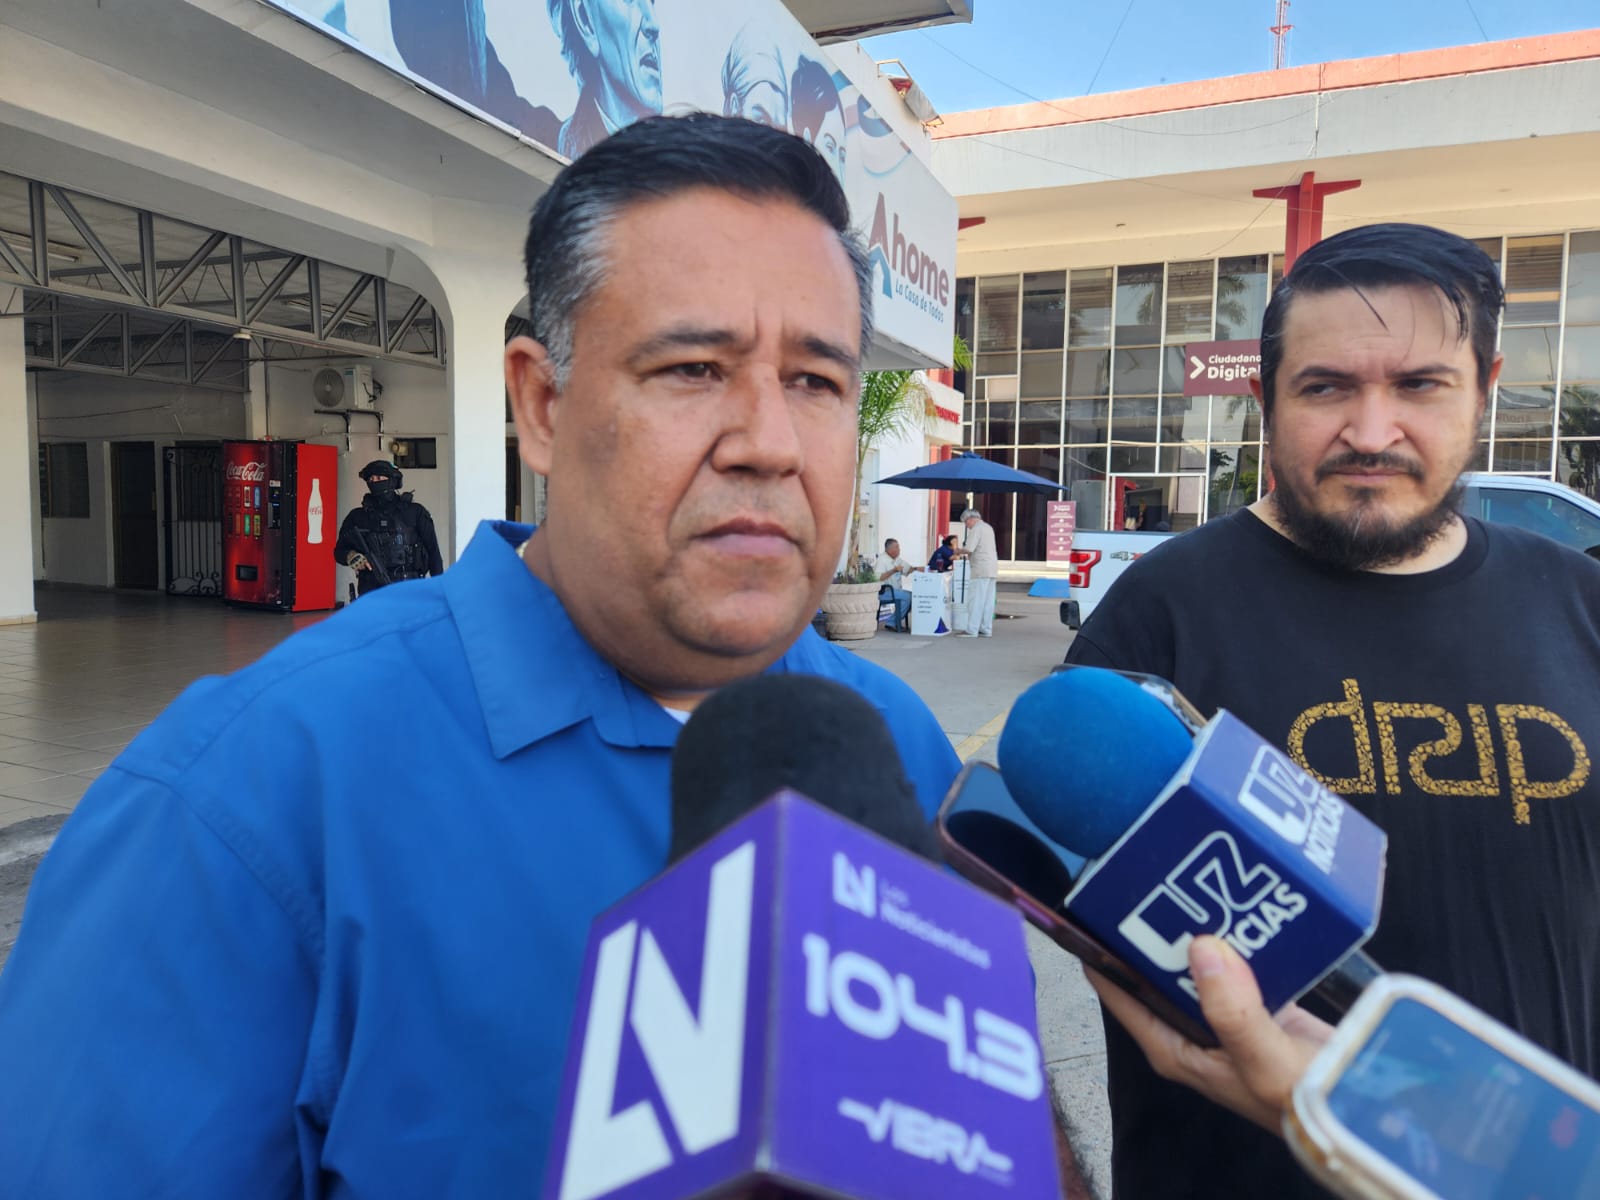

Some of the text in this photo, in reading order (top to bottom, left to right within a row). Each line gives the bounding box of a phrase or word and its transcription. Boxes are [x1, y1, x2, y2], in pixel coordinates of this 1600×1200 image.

[868, 191, 949, 307] Ahome
[895, 278, 944, 324] La Casa de Todos
[1110, 551, 1148, 562] 4X
[803, 932, 1044, 1101] 104.3
